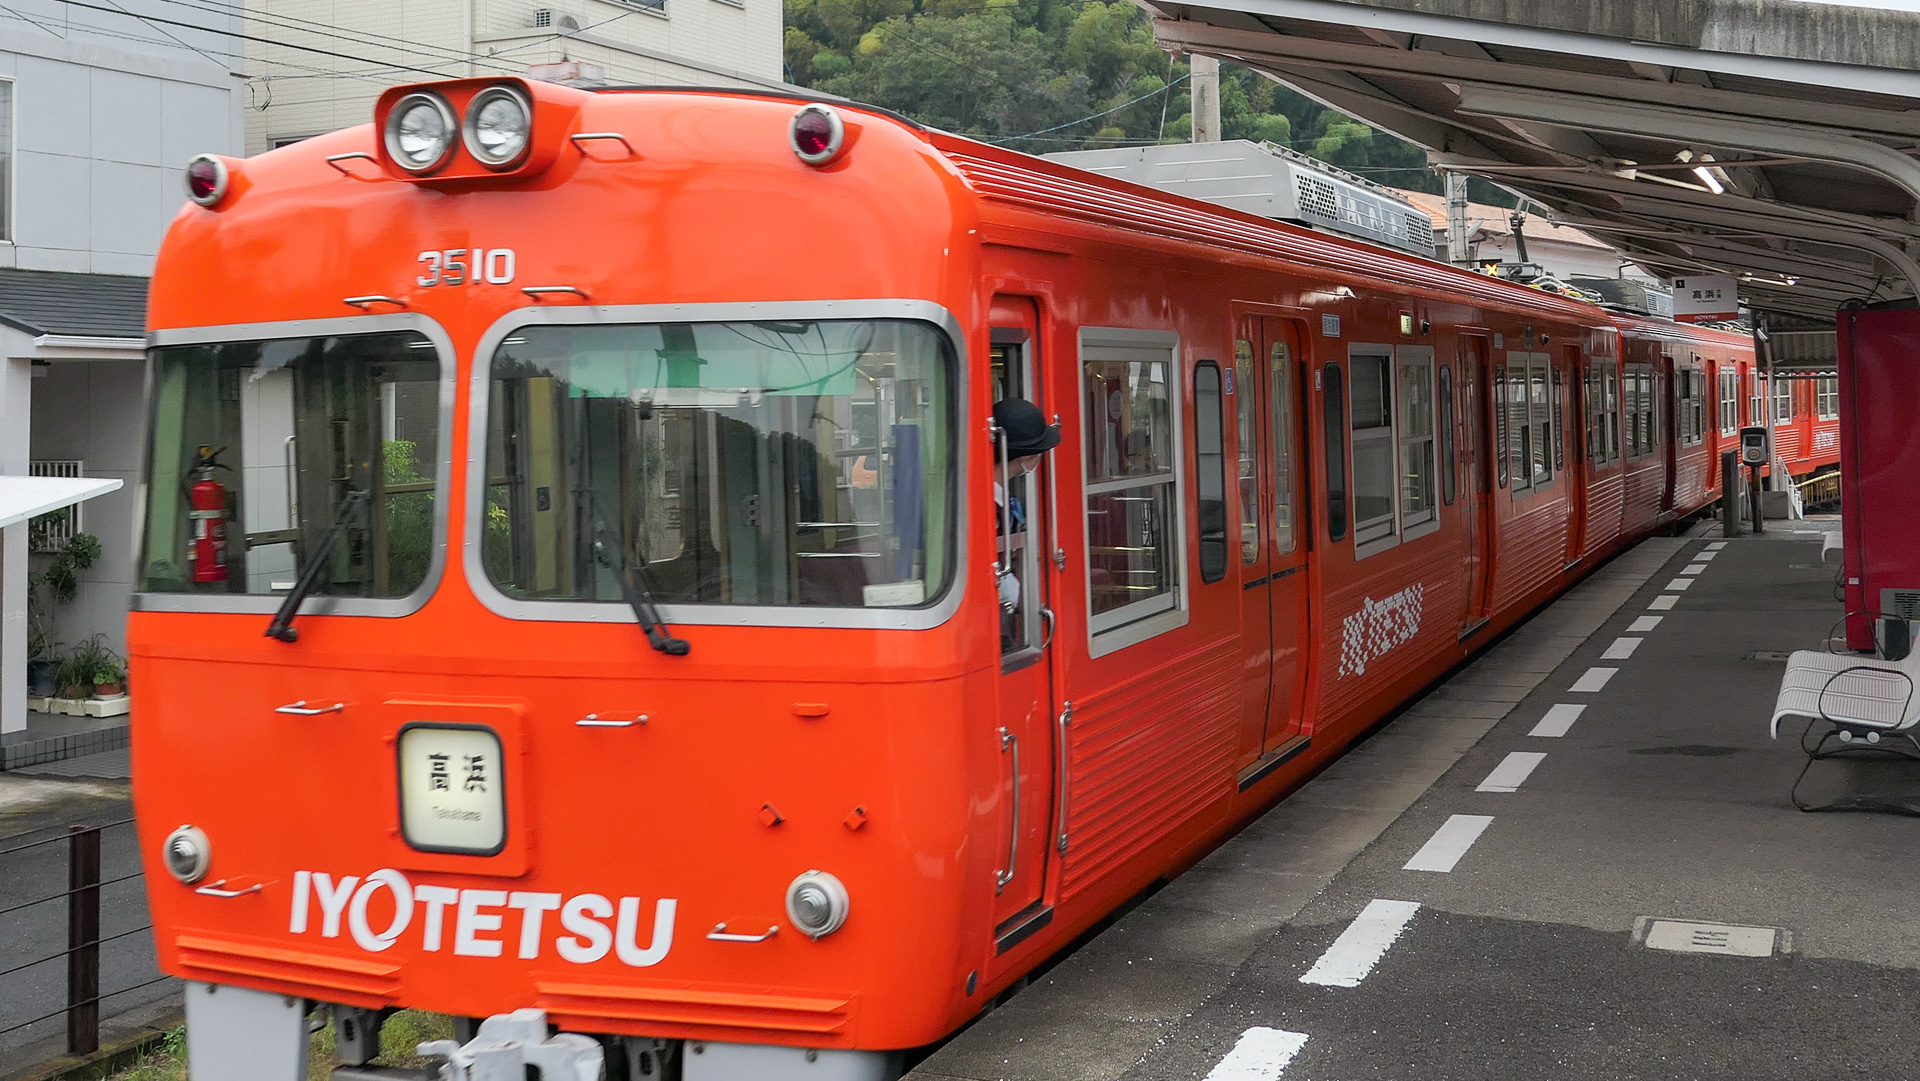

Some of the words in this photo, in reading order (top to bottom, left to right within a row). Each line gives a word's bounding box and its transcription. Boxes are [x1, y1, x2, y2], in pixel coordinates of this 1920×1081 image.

[416, 248, 516, 287] 3510
[1692, 290, 1715, 299] 高浜
[427, 752, 488, 794] 高浜
[288, 868, 678, 967] IYOTETSU
